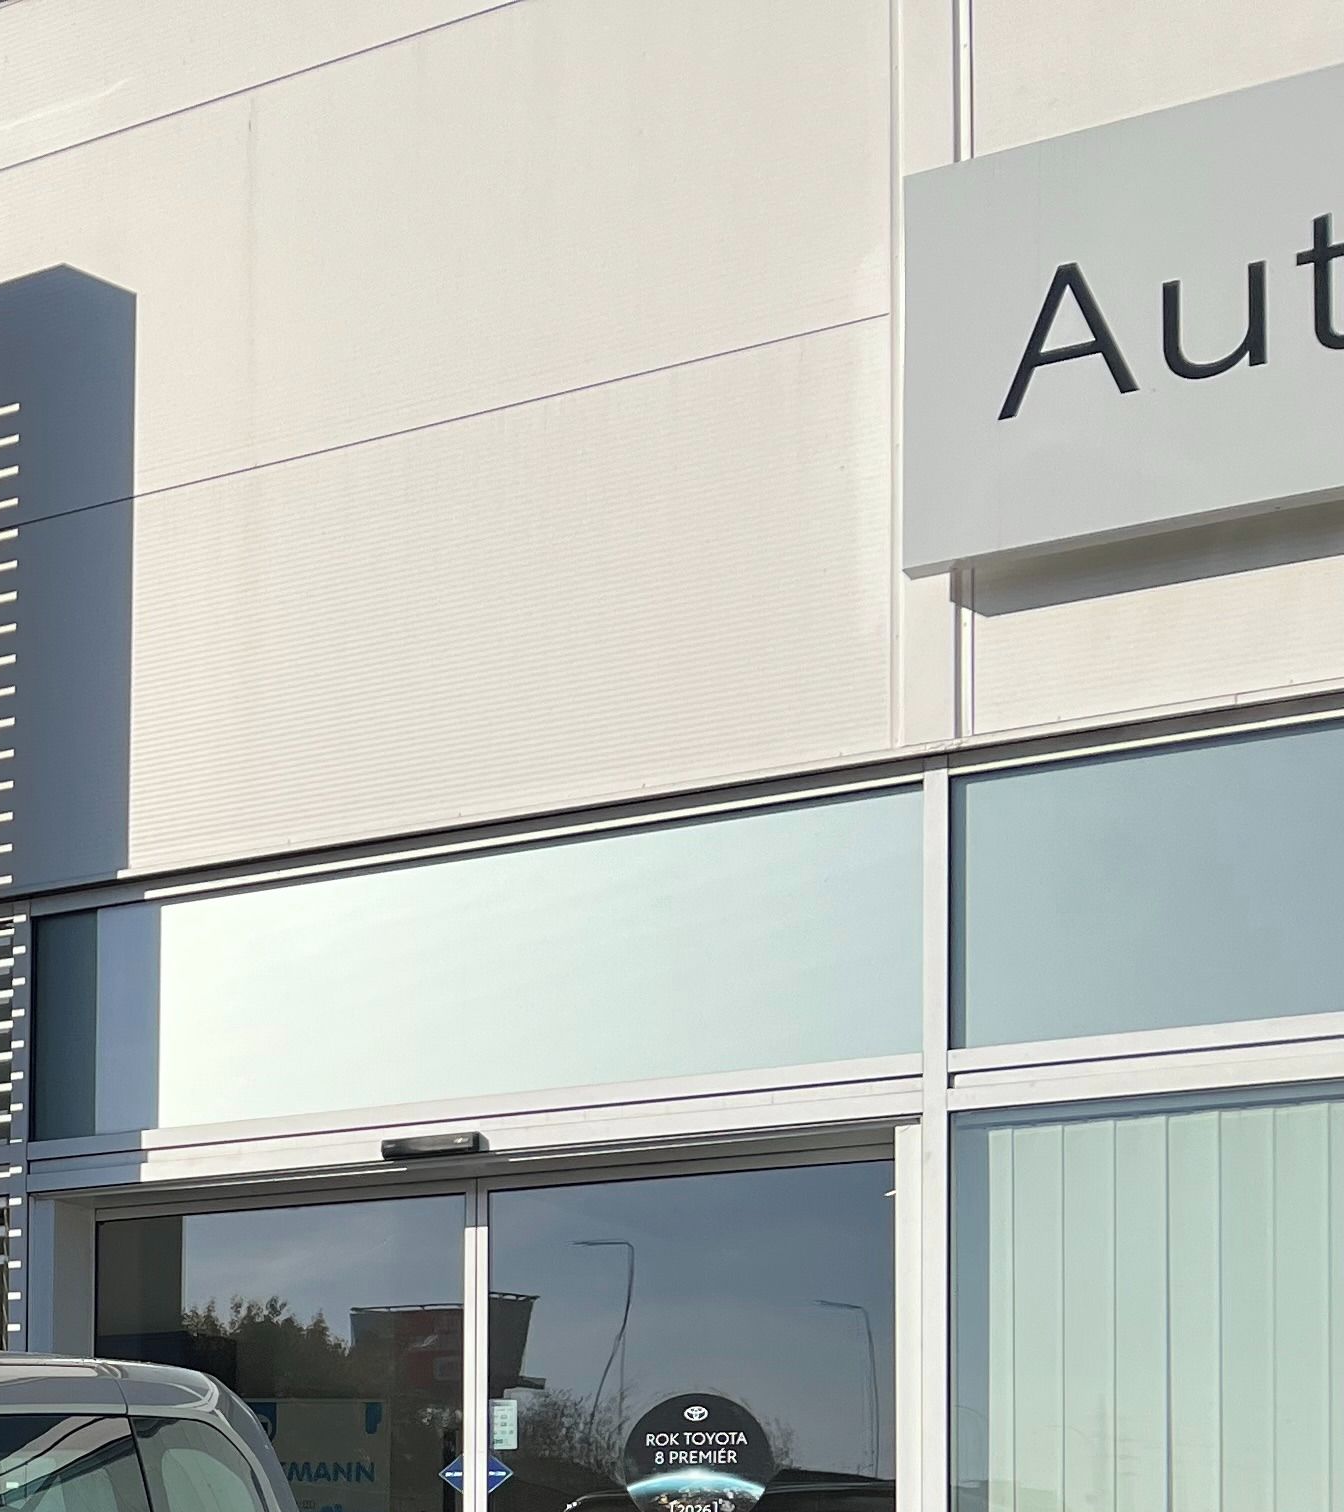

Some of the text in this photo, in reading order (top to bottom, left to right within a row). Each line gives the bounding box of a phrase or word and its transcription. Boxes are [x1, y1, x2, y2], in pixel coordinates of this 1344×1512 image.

[645, 1431, 748, 1447] ROK TOYOTA
[654, 1447, 738, 1465] 8 PREMIÉR
